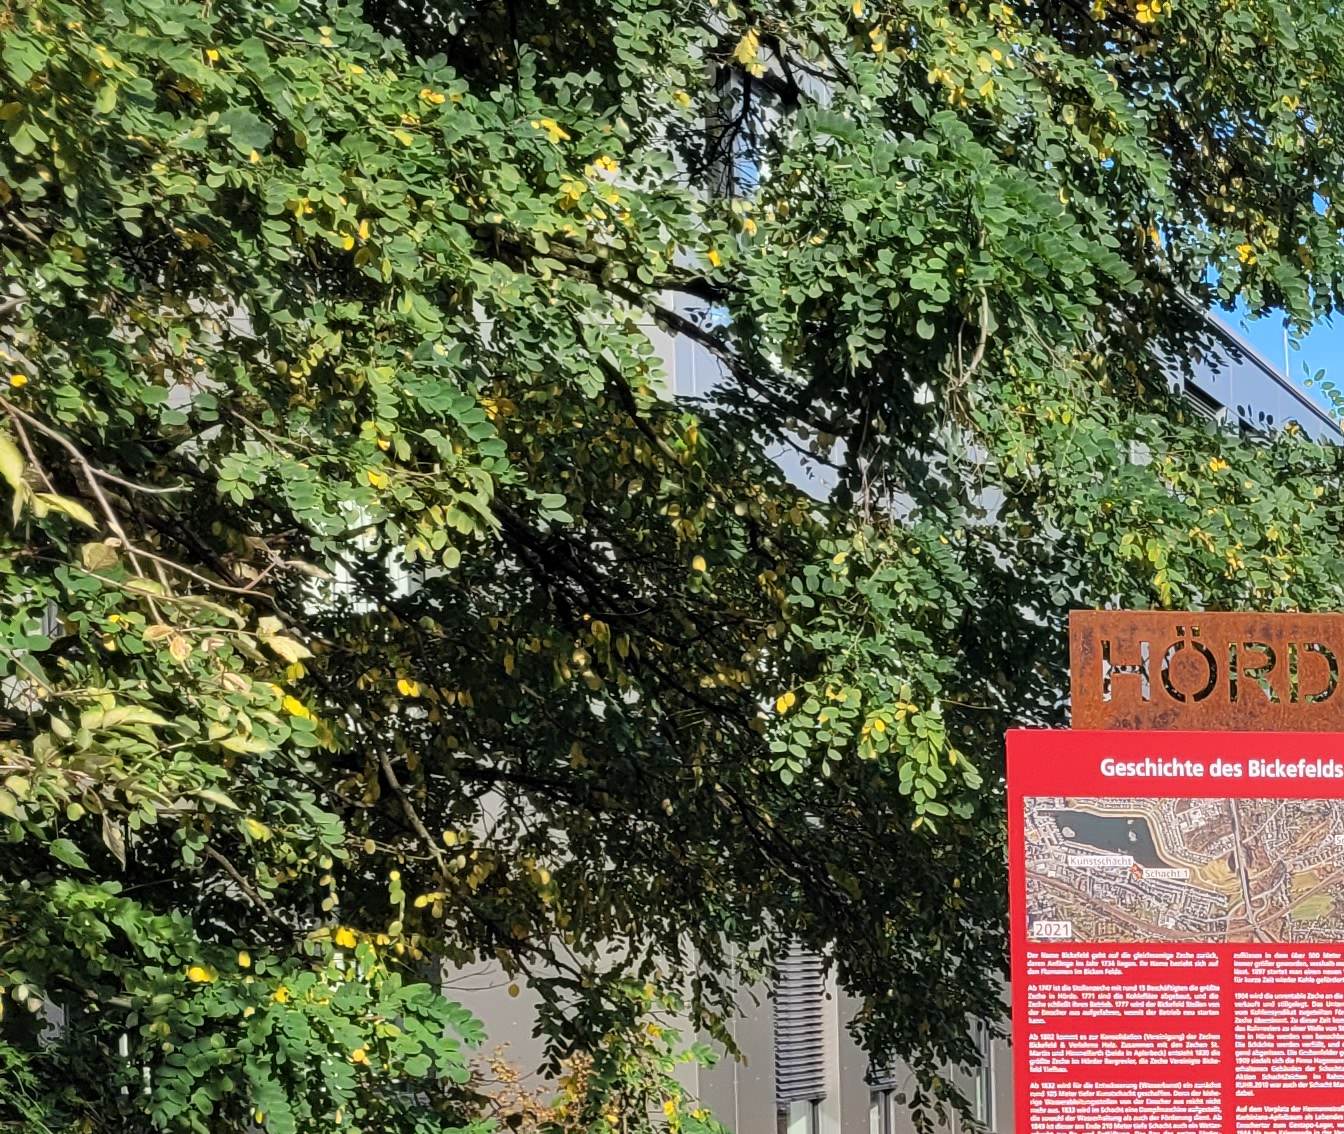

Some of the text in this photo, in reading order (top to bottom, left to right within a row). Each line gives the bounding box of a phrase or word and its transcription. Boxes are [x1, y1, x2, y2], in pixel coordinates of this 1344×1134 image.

[1100, 757, 1344, 778] Geschichte des Bickefelds
[1070, 856, 1132, 866] Kunstschacht
[1144, 870, 1180, 878] Schacht
[1035, 923, 1069, 936] 2021
